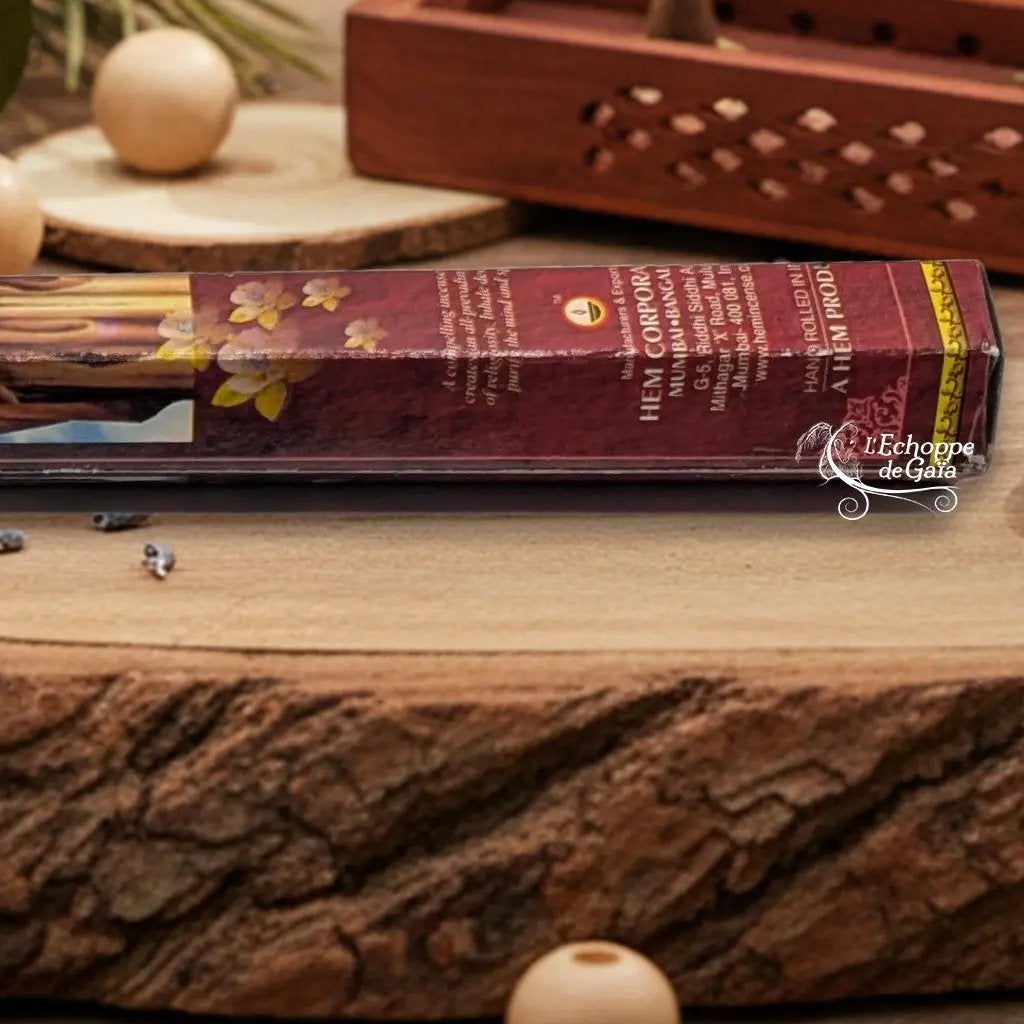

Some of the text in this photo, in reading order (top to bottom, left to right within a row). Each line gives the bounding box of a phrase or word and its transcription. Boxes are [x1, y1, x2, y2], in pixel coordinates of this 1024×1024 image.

[726, 302, 743, 325] 400
[793, 288, 818, 341] ROLLED
[829, 324, 853, 371] HEM
[638, 367, 664, 420] HEM
[709, 347, 734, 411] Mithagar
[830, 377, 849, 393] A
